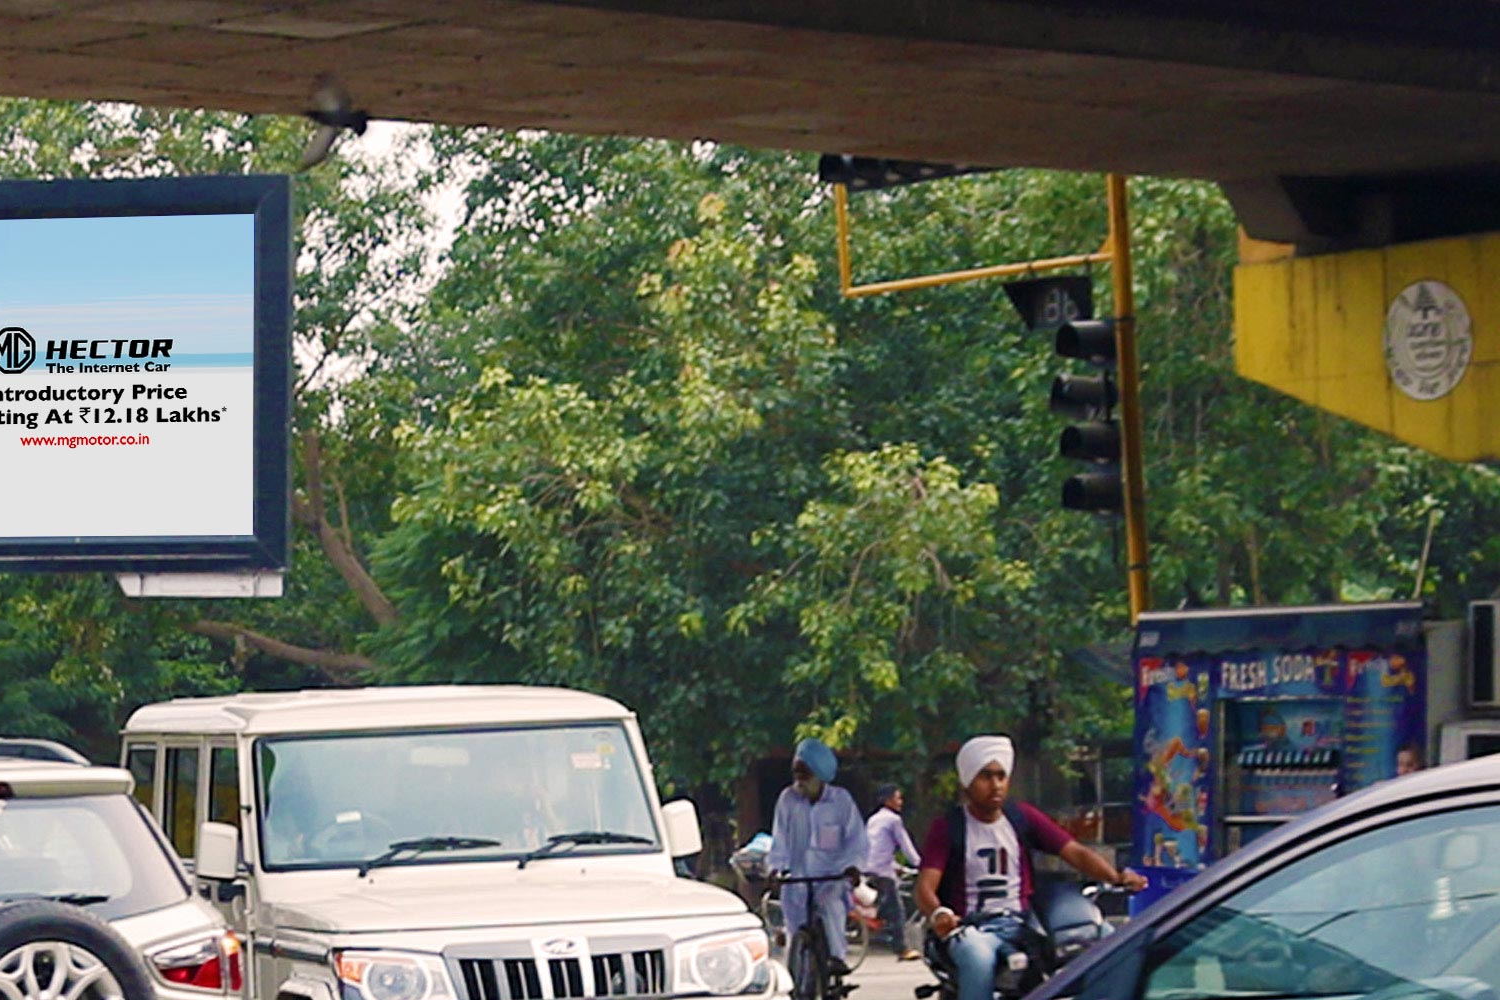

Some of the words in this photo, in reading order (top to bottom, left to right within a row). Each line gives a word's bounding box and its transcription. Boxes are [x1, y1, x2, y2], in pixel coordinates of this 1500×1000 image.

[46, 339, 174, 360] HECTOR
[46, 363, 75, 374] The
[79, 362, 140, 373] Internet
[144, 361, 171, 373] Car
[132, 384, 188, 400] Price
[44, 408, 73, 425] At
[79, 406, 149, 424] ₹12.18
[20, 433, 150, 448] www.mgmotor.co.in
[1221, 659, 1267, 691] FRESH
[1272, 654, 1316, 684] SODA
